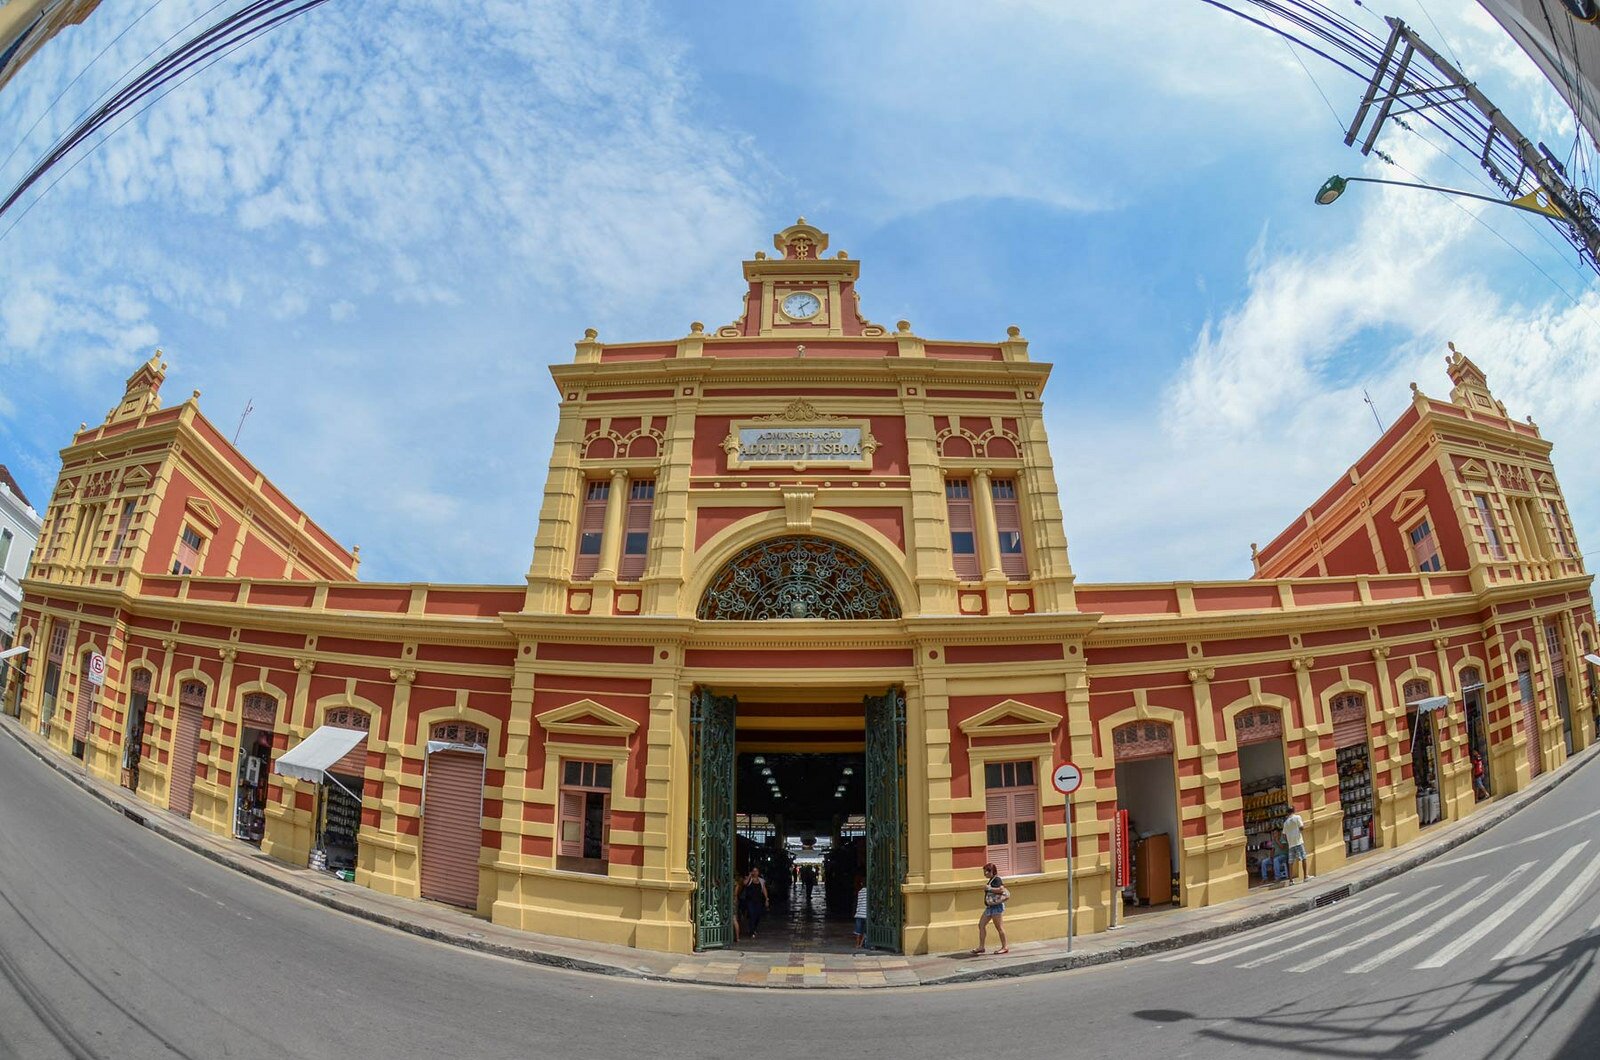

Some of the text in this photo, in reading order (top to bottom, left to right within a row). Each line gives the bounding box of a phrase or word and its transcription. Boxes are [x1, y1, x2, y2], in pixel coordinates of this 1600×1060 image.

[758, 431, 843, 441] ADMINISTRAÇÃO
[740, 444, 861, 456] ADOLPHO LISBOA
